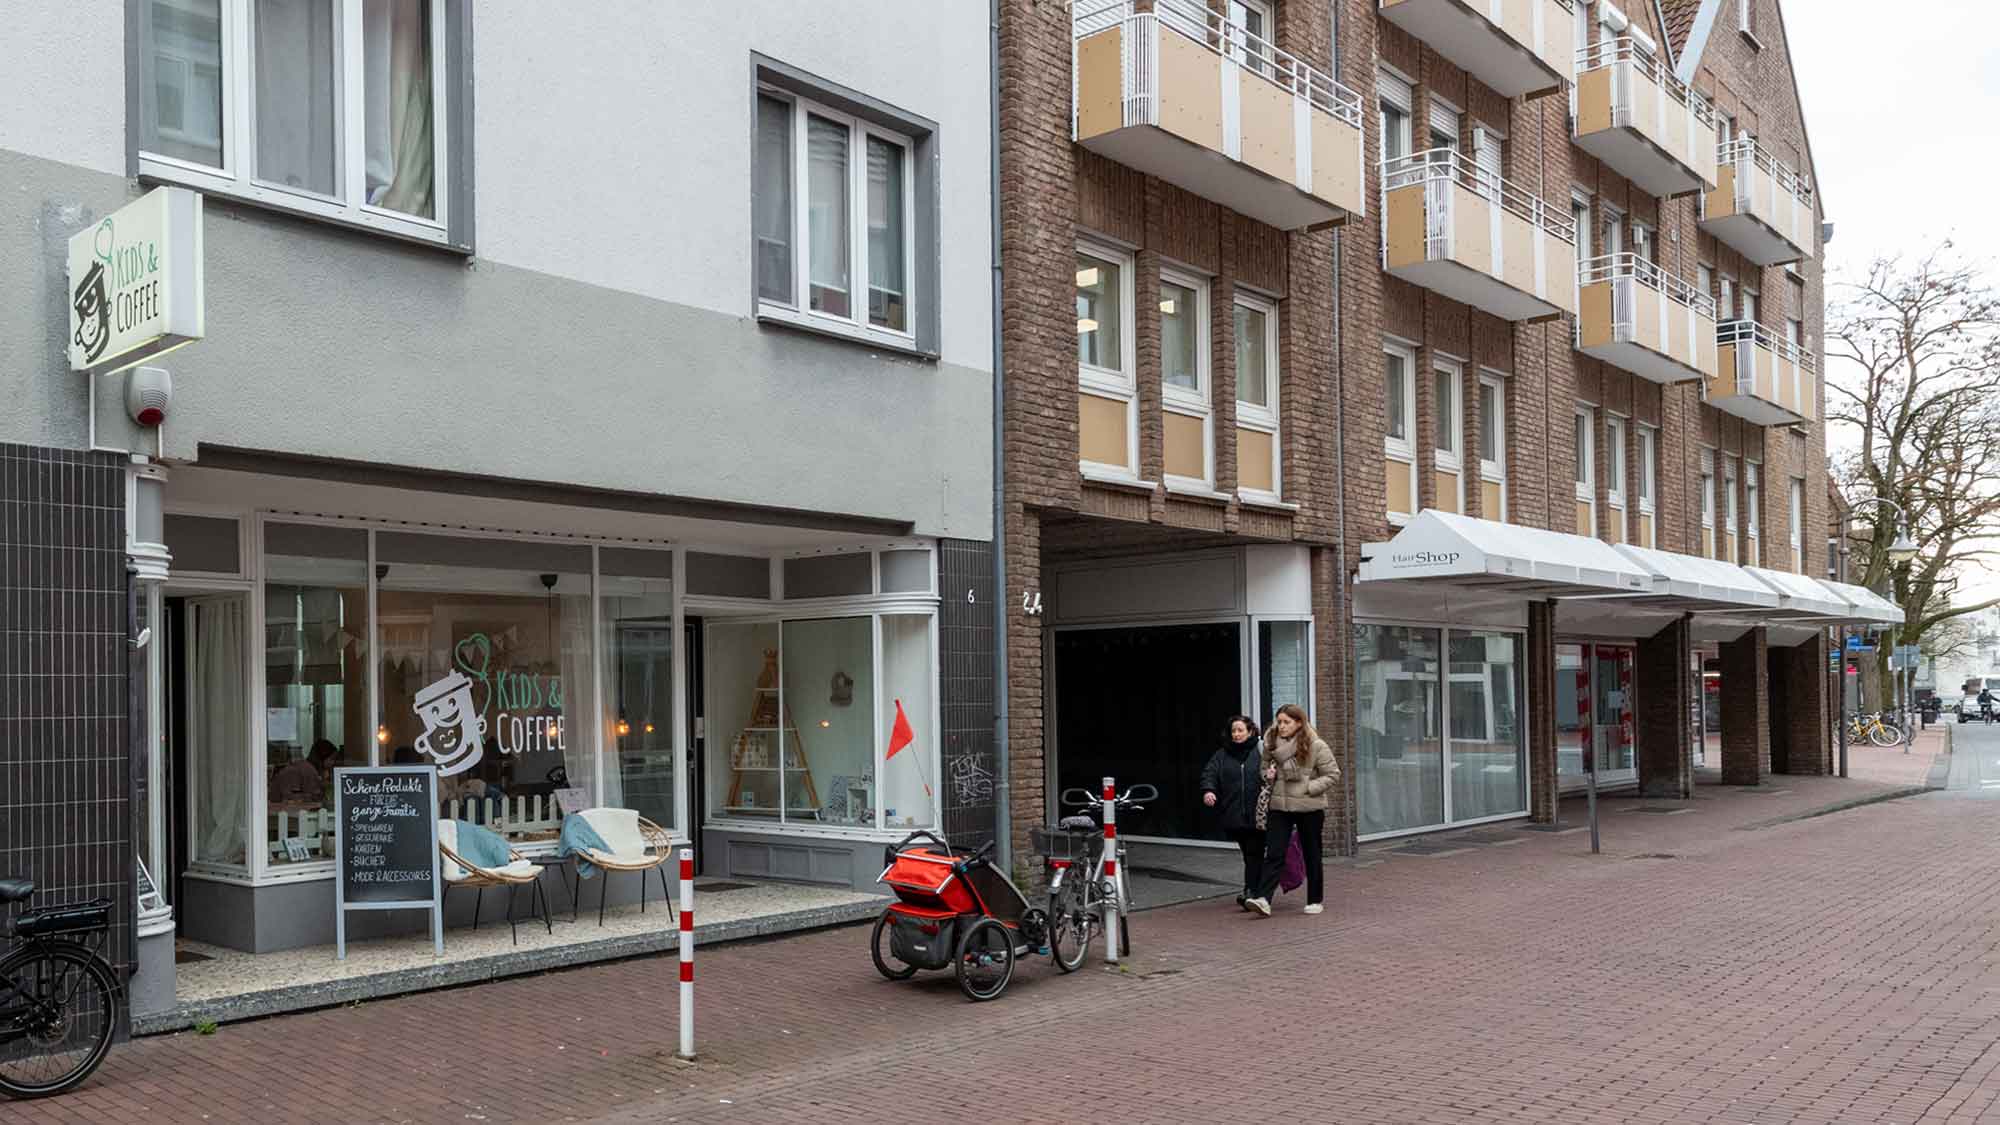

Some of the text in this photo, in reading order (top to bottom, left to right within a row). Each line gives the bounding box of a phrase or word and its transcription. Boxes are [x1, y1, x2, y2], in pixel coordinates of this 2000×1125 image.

[148, 243, 158, 273] &
[116, 280, 159, 334] COFFEE
[967, 589, 975, 604] 6
[1023, 591, 1043, 615] 24
[496, 671, 562, 711] KIDS &
[496, 713, 566, 754] COFFEE
[382, 777, 423, 793] Produkte
[351, 806, 382, 822] ganze
